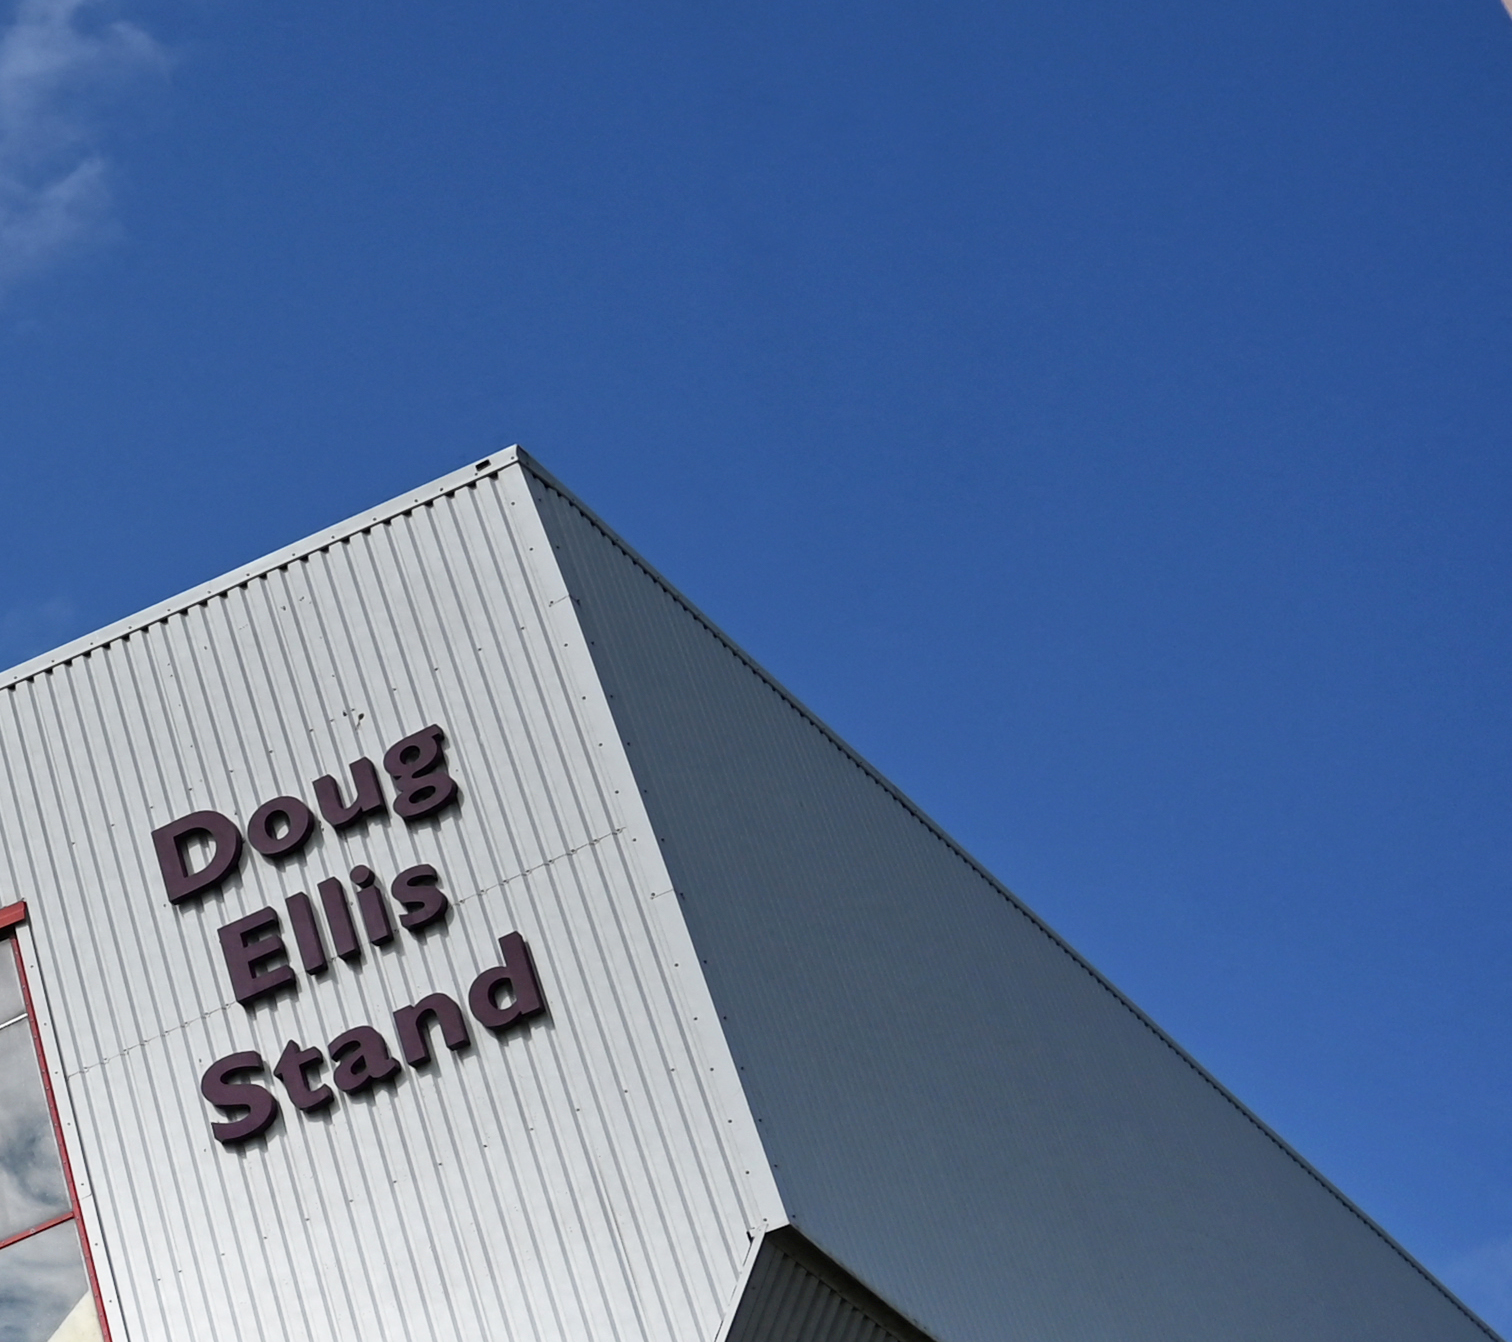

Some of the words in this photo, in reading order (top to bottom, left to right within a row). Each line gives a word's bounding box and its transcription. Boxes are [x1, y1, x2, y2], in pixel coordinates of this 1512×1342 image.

[151, 724, 457, 904] Doug
[217, 864, 447, 1005] Ellis
[201, 931, 545, 1144] Stand
